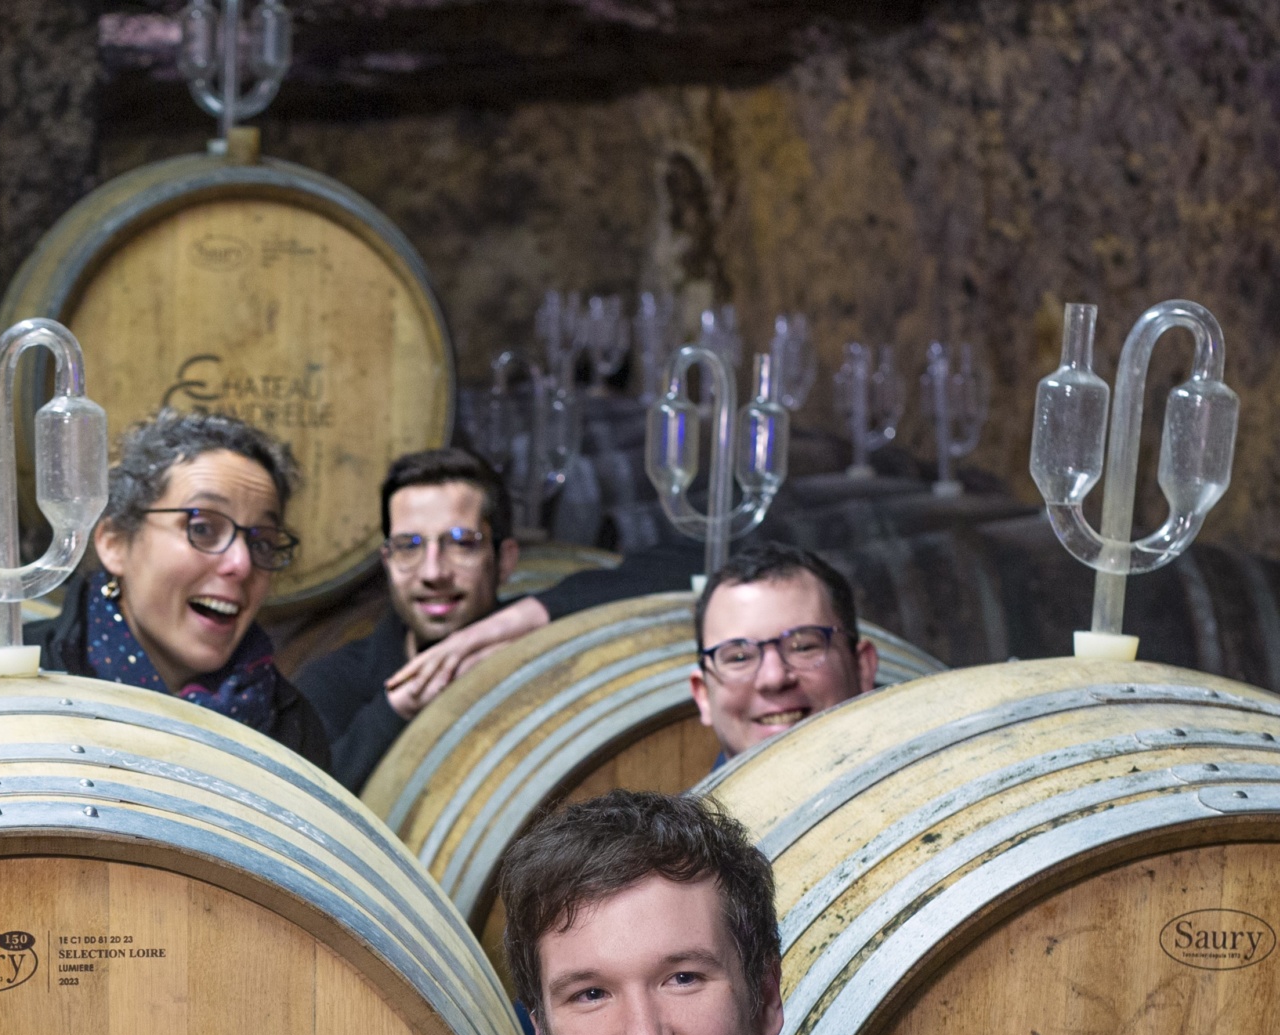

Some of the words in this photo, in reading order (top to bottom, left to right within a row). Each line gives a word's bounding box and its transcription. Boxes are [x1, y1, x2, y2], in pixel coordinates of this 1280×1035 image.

[5, 934, 28, 944] 150
[123, 936, 133, 944] 23
[1175, 920, 1263, 960] Saury
[58, 949, 126, 959] SELECTION
[129, 949, 166, 958] LOIRE
[58, 964, 95, 972] LUMIERE
[59, 978, 79, 986] 2023
